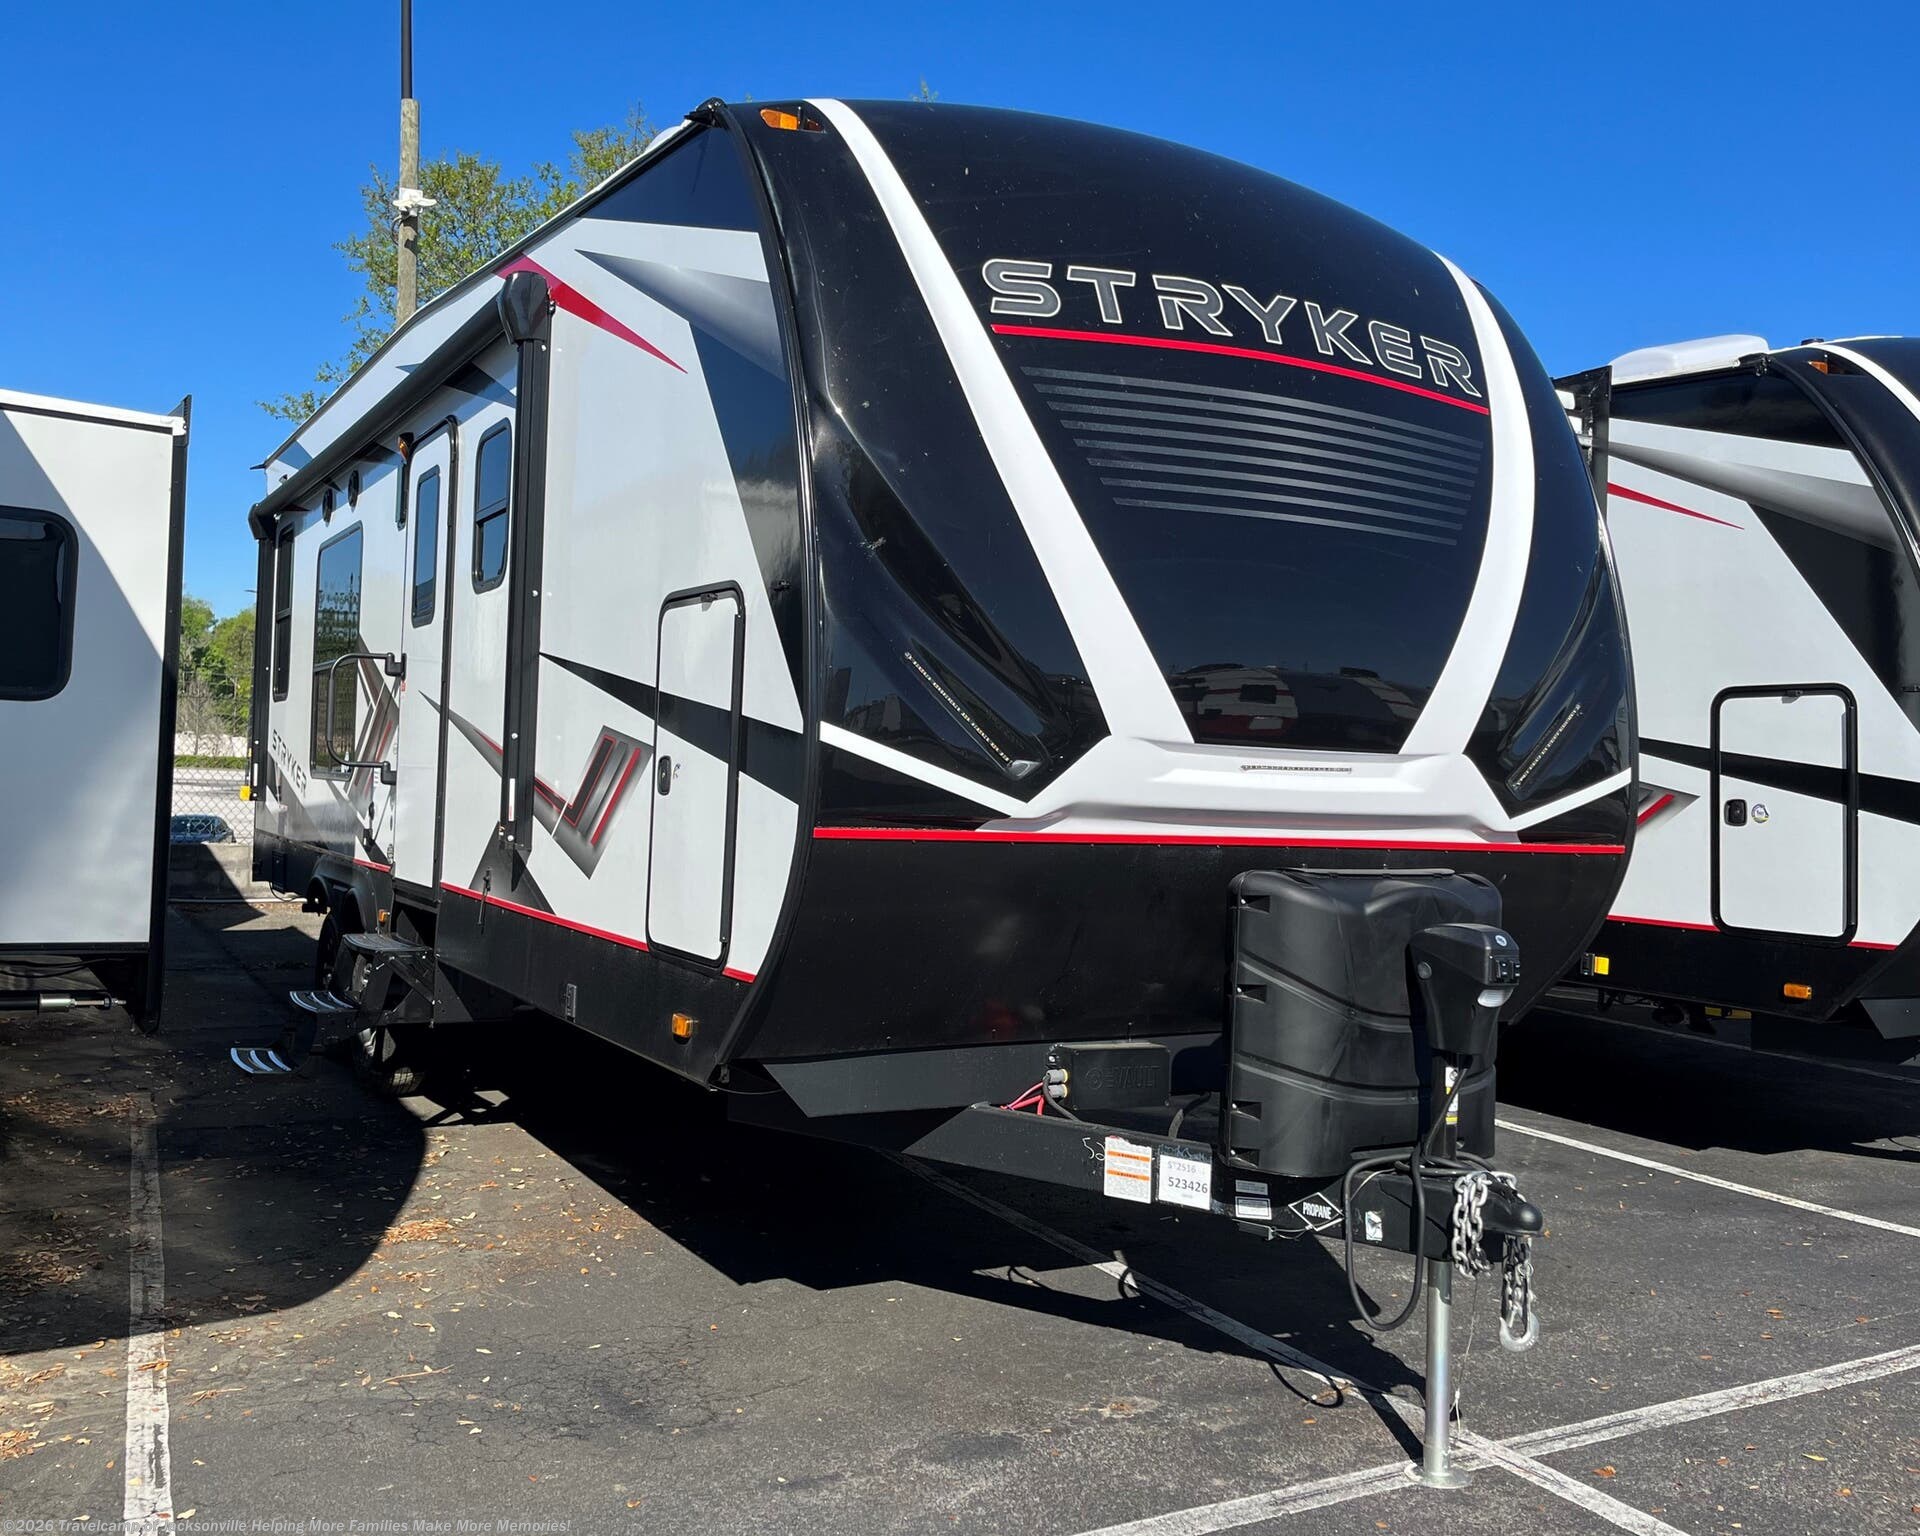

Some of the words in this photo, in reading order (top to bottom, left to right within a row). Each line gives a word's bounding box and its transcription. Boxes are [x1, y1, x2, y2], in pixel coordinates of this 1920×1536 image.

[982, 258, 1482, 398] STRYKER
[272, 729, 307, 798] STRYKER
[1168, 1176, 1208, 1194] 523426
[1302, 1202, 1332, 1220] PROPANE
